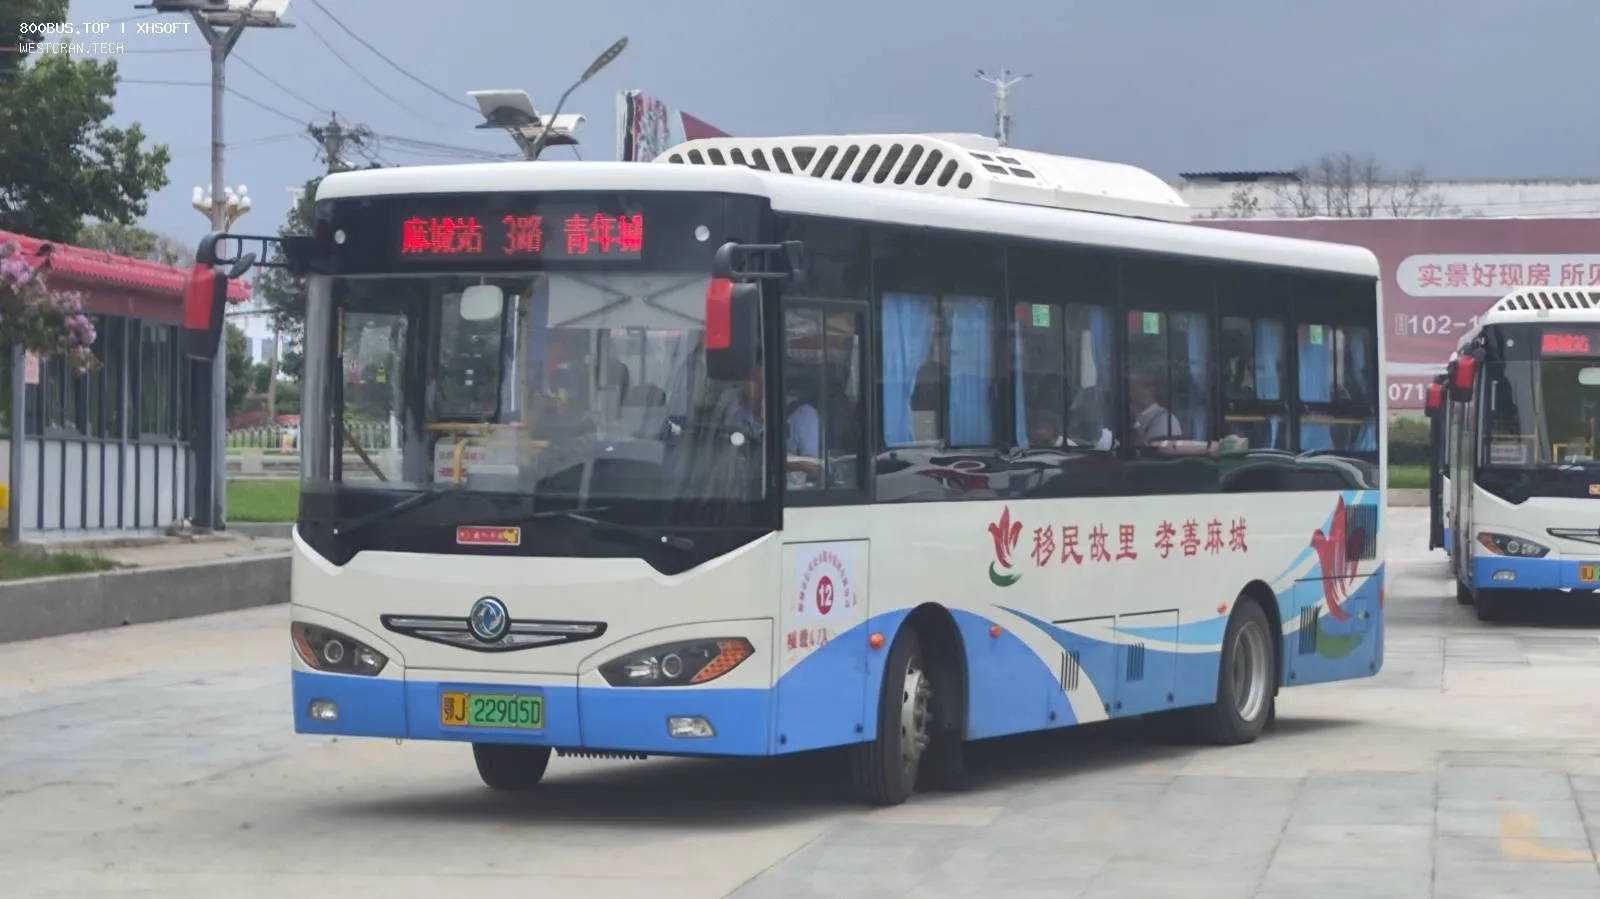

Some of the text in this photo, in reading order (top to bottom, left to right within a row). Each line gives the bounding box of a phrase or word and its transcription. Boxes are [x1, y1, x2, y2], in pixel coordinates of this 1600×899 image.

[1417, 263, 1551, 288] 实景好现房
[1388, 383, 1433, 401] 071
[1031, 515, 1248, 567] 移民故里 孝善麻城
[818, 583, 833, 608] 12
[474, 698, 541, 724] 22905D
